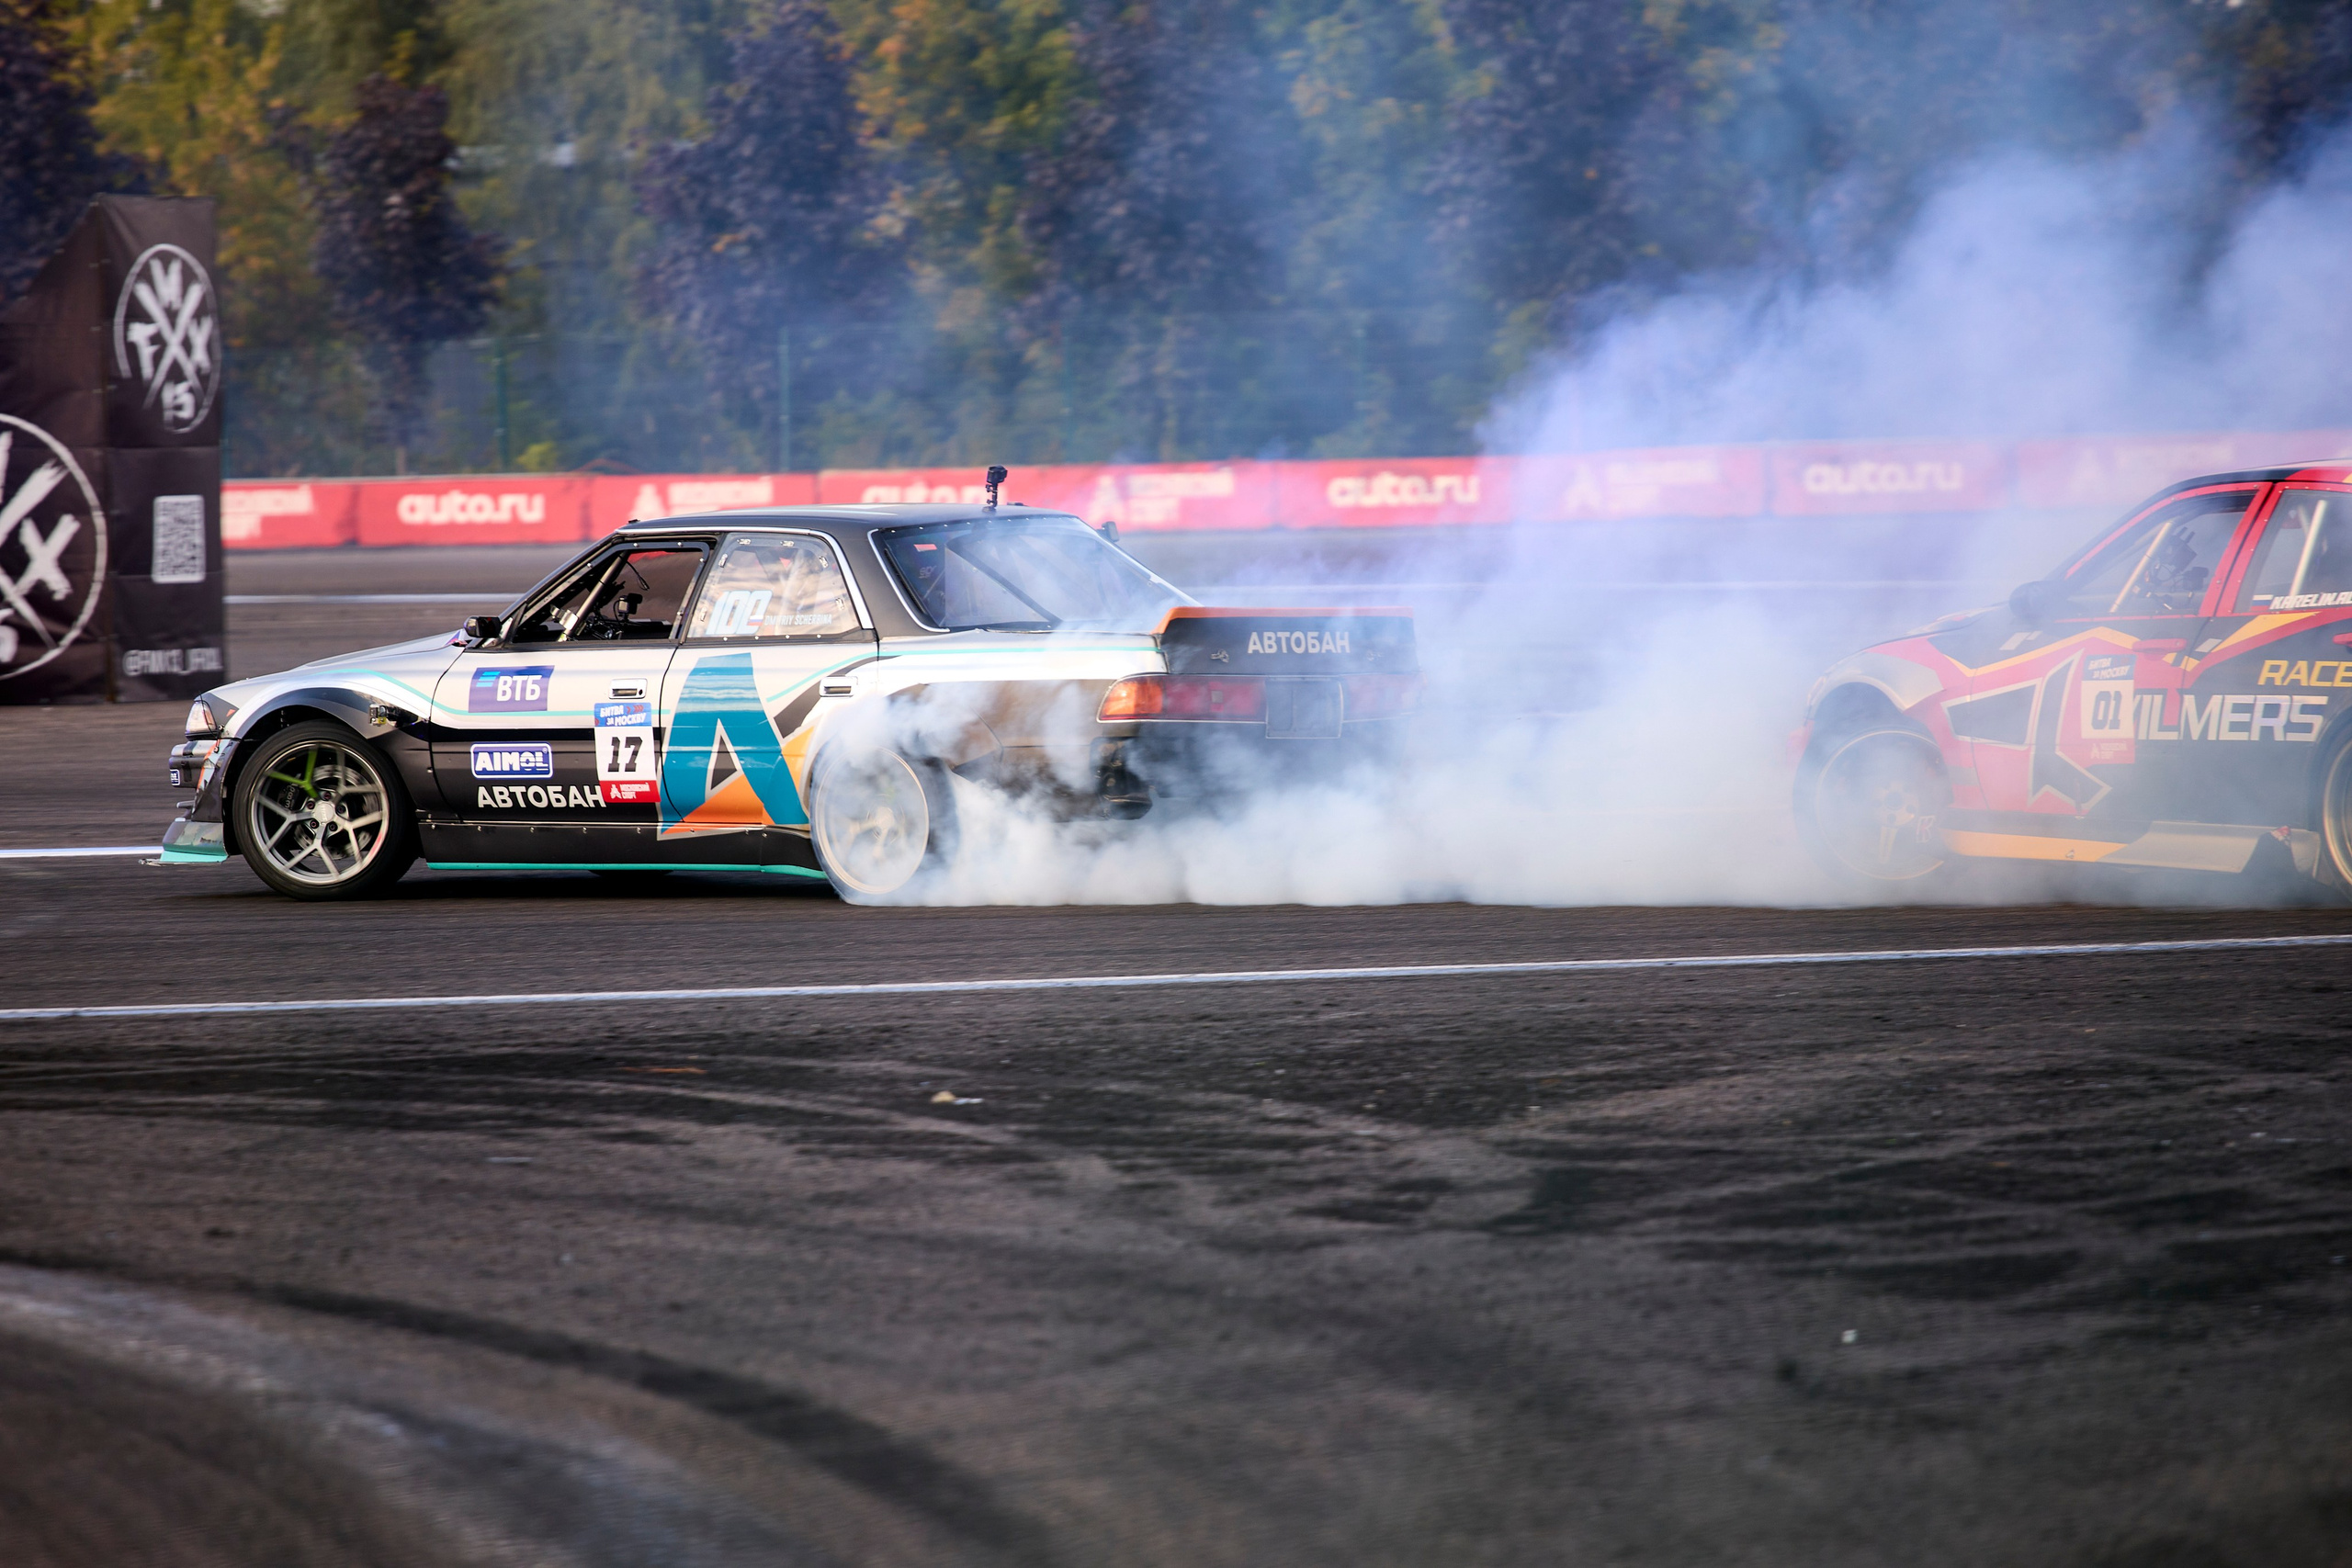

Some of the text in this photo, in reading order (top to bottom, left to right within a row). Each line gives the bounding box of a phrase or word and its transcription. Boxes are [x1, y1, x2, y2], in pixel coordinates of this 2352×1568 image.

[1328, 471, 1480, 508] auto.ru
[1804, 461, 1964, 494] auto.ru
[397, 490, 546, 525] auto.ru
[1247, 631, 1351, 654] АВТОБАН
[496, 674, 543, 702] ВТБ
[2091, 691, 2122, 729] 01
[475, 751, 549, 772] AIMOL
[607, 737, 643, 773] 17
[478, 785, 607, 808] АВТОБАН
